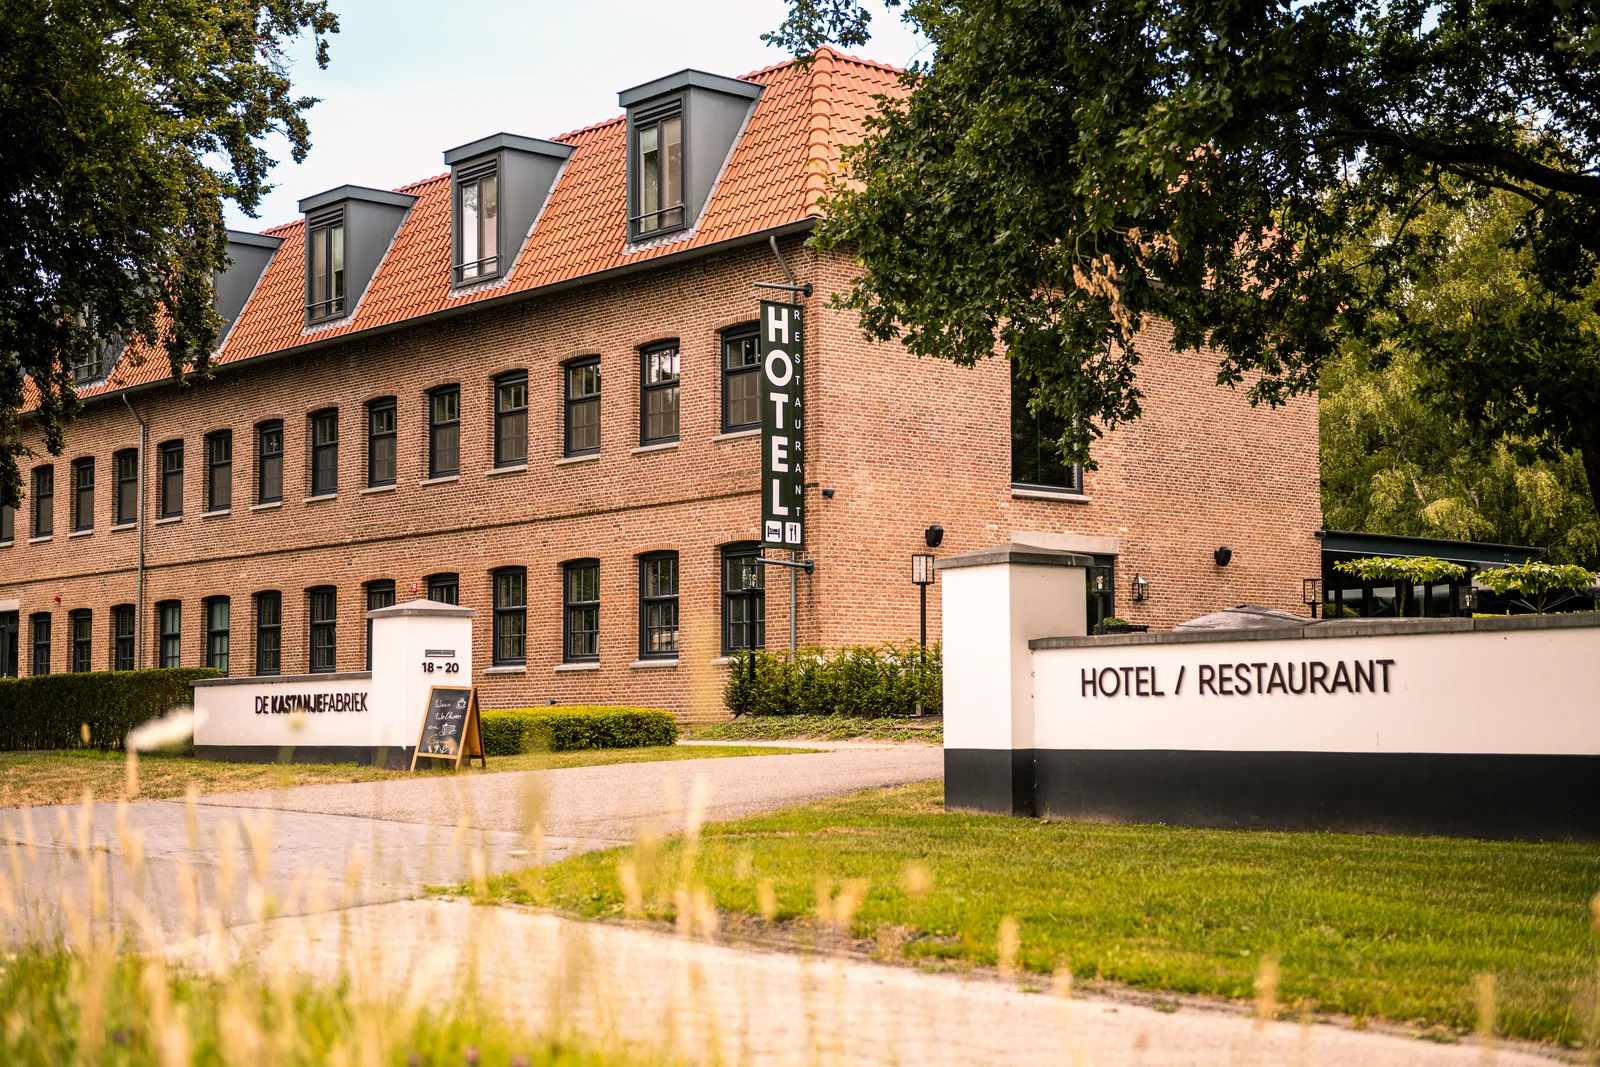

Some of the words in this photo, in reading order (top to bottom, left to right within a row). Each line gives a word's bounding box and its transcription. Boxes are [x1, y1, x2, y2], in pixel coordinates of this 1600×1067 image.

[764, 305, 793, 516] HOTEL
[793, 309, 802, 518] RESTAURANT
[255, 695, 269, 714] DE
[271, 692, 368, 714] KASTANJEFABRIEK
[1081, 665, 1164, 697] HOTEL
[1174, 665, 1185, 695] /
[1199, 659, 1395, 696] RESTAURANT
